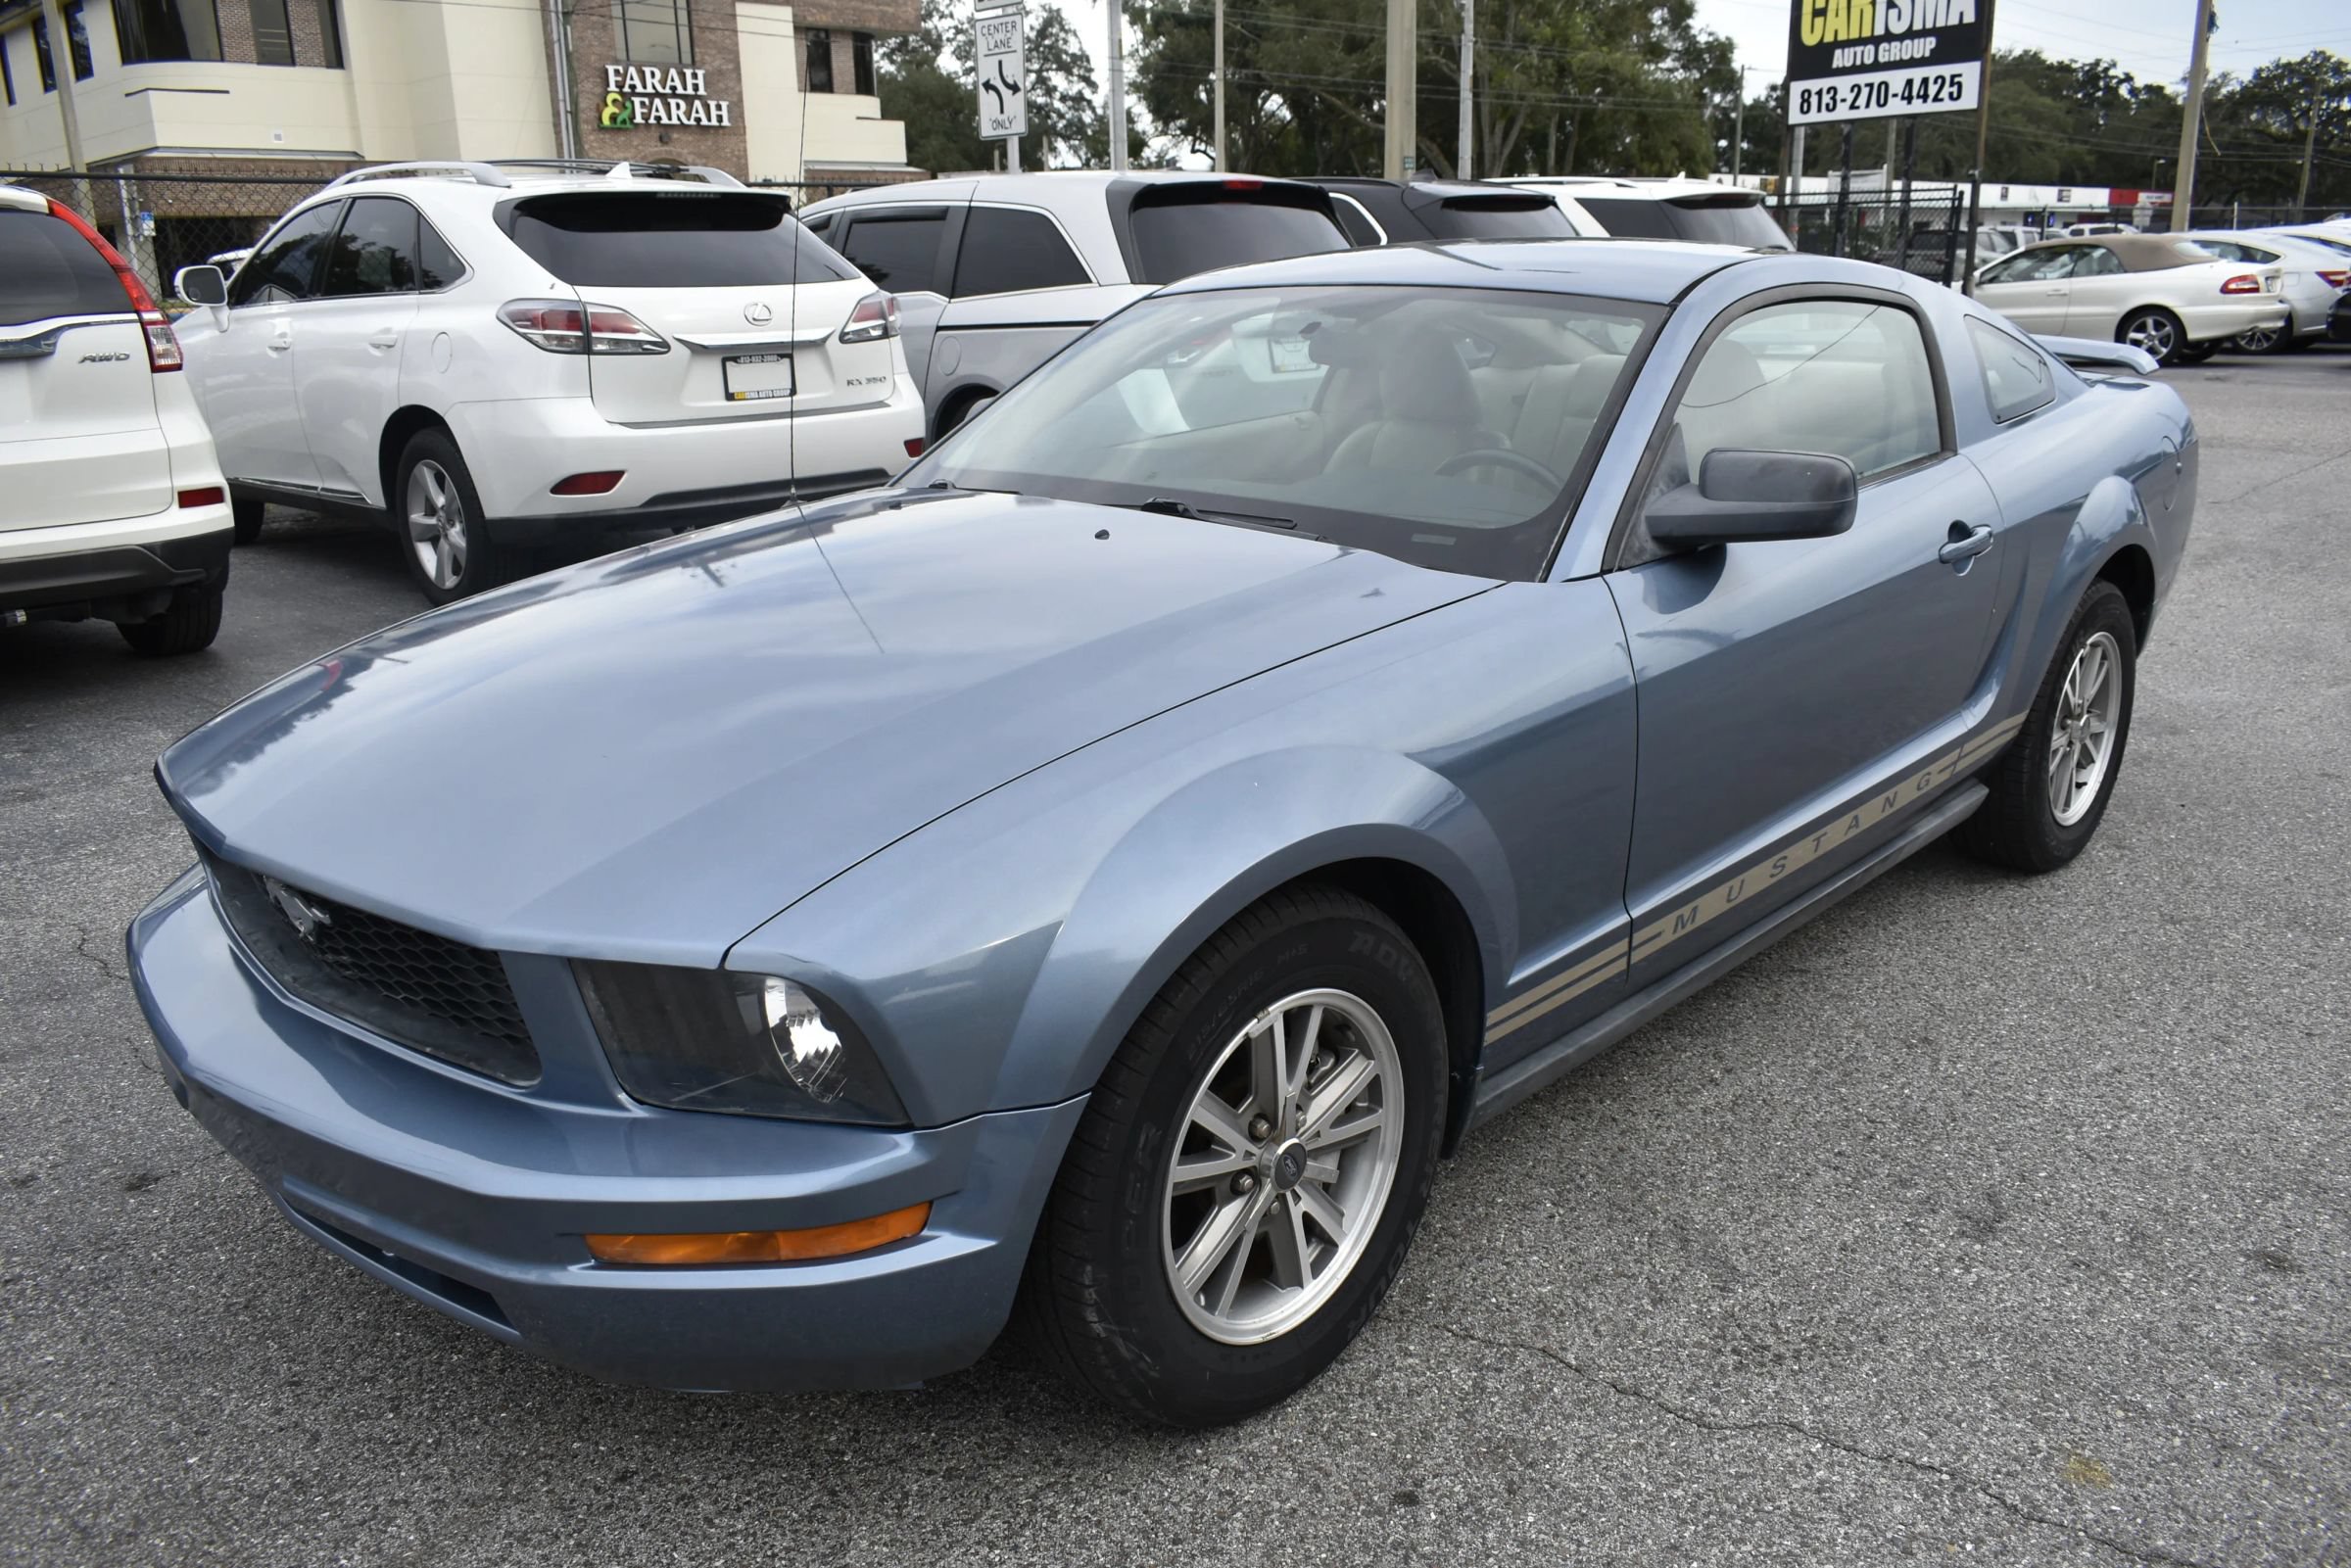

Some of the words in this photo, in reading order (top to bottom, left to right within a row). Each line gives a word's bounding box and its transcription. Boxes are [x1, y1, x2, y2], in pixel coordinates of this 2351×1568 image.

[981, 20, 1018, 37] CENTER
[986, 36, 1012, 51] LANE
[1832, 45, 1875, 69] AUTO
[1878, 36, 1937, 63] GROUP
[605, 64, 707, 95] FARAH
[1799, 73, 1964, 116] 813-270-4425
[631, 96, 732, 126] FARAH
[78, 352, 130, 363] AWD
[846, 378, 862, 387] RX
[1672, 771, 1933, 936] MUSTANG
